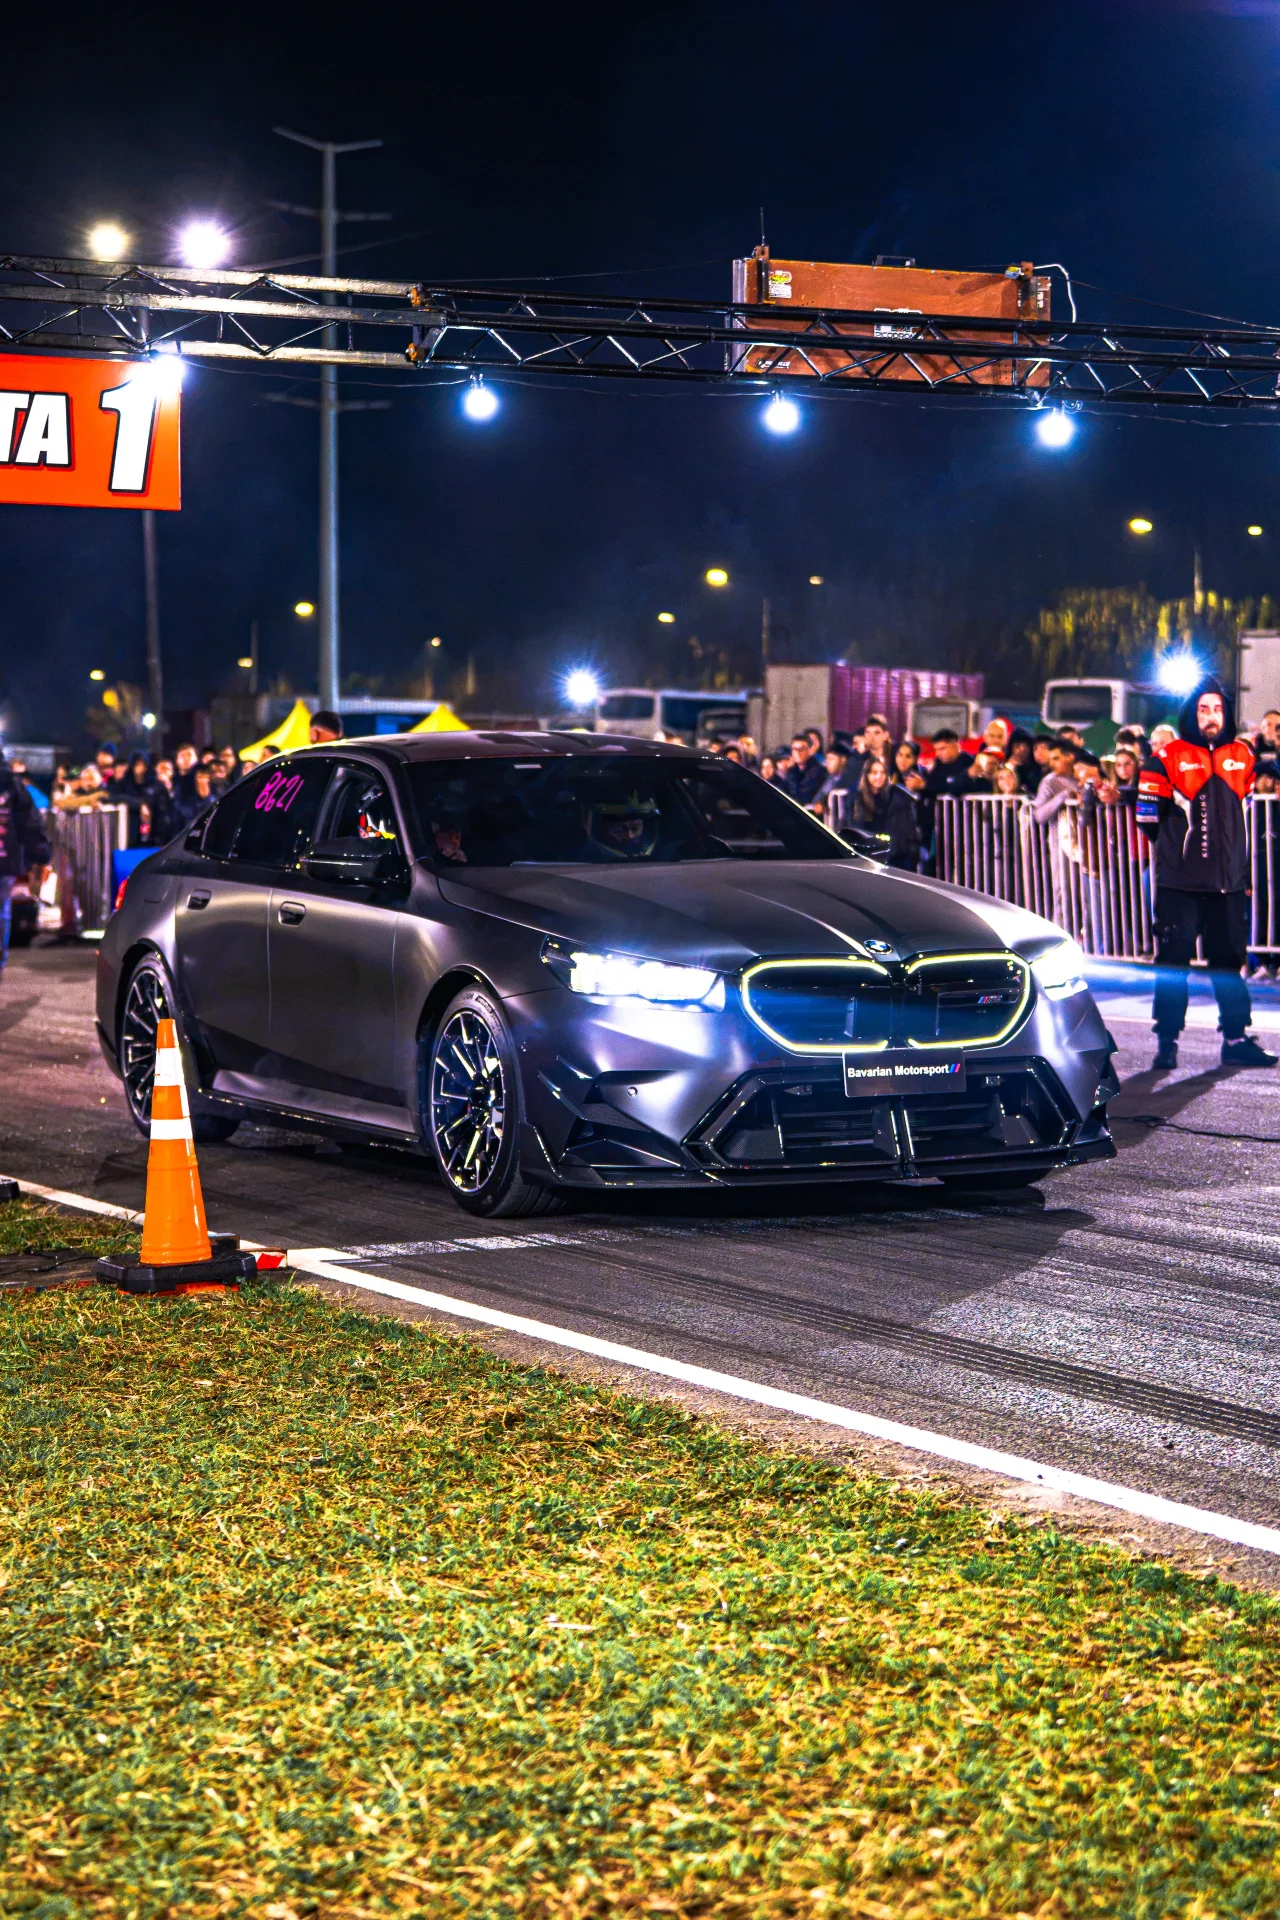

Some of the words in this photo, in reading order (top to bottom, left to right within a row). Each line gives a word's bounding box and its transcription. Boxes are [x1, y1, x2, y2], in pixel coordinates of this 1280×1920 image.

[99, 371, 158, 493] 1
[255, 770, 304, 812] 8621
[847, 1066, 893, 1078] Bavarian
[894, 1063, 950, 1077] Motorsport
